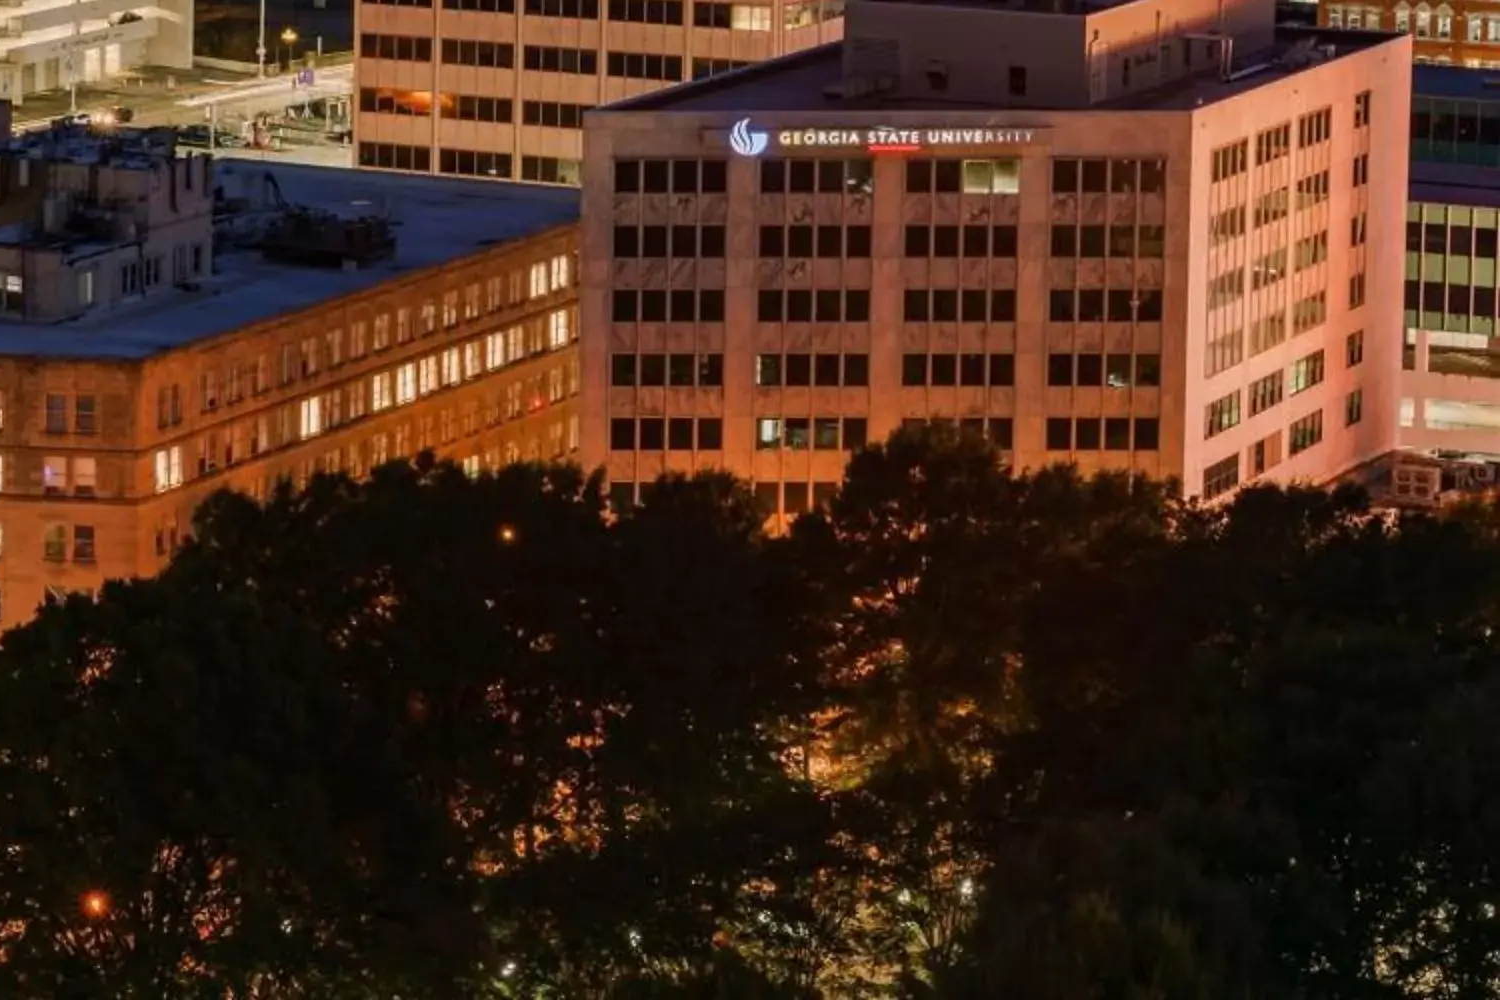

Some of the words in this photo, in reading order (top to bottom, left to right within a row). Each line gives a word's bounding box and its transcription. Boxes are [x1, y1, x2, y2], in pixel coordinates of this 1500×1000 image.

[779, 129, 860, 145] GEORGIA
[866, 129, 920, 145] STATE
[927, 129, 1033, 144] UNIVERSITY
